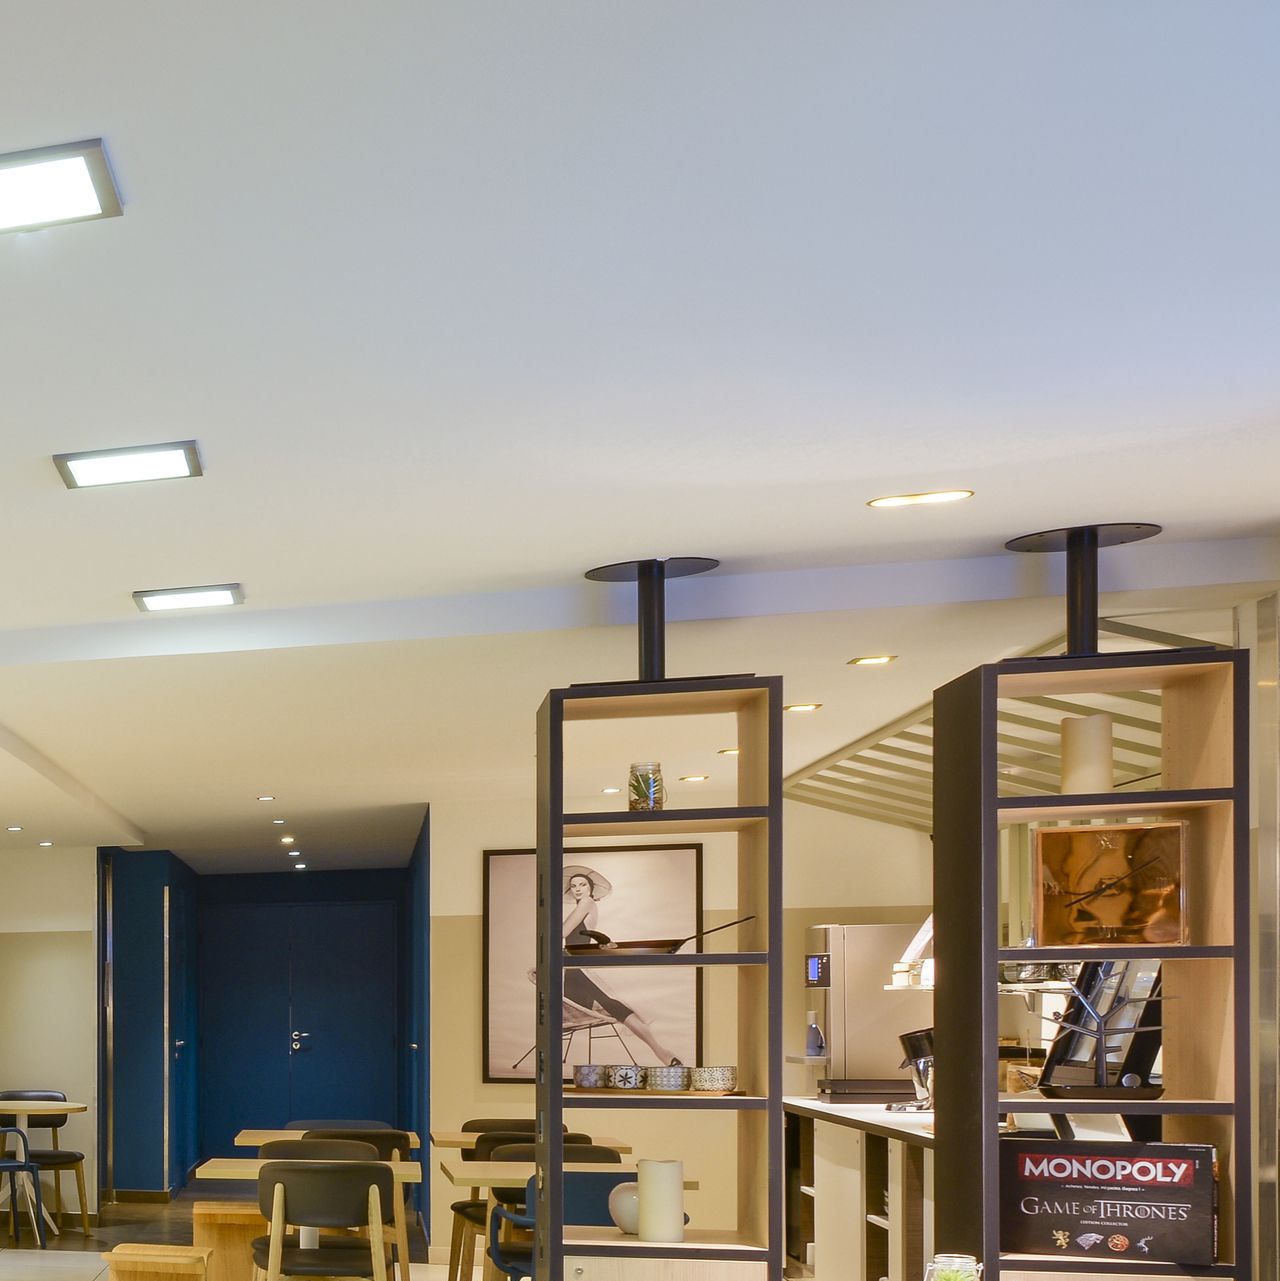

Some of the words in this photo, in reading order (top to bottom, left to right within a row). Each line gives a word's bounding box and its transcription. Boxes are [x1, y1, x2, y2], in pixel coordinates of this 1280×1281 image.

[1024, 1157, 1188, 1183] MONOPOLY
[1020, 1196, 1080, 1216] GAME
[1082, 1204, 1099, 1215] OF
[1094, 1199, 1192, 1222] THRONES
